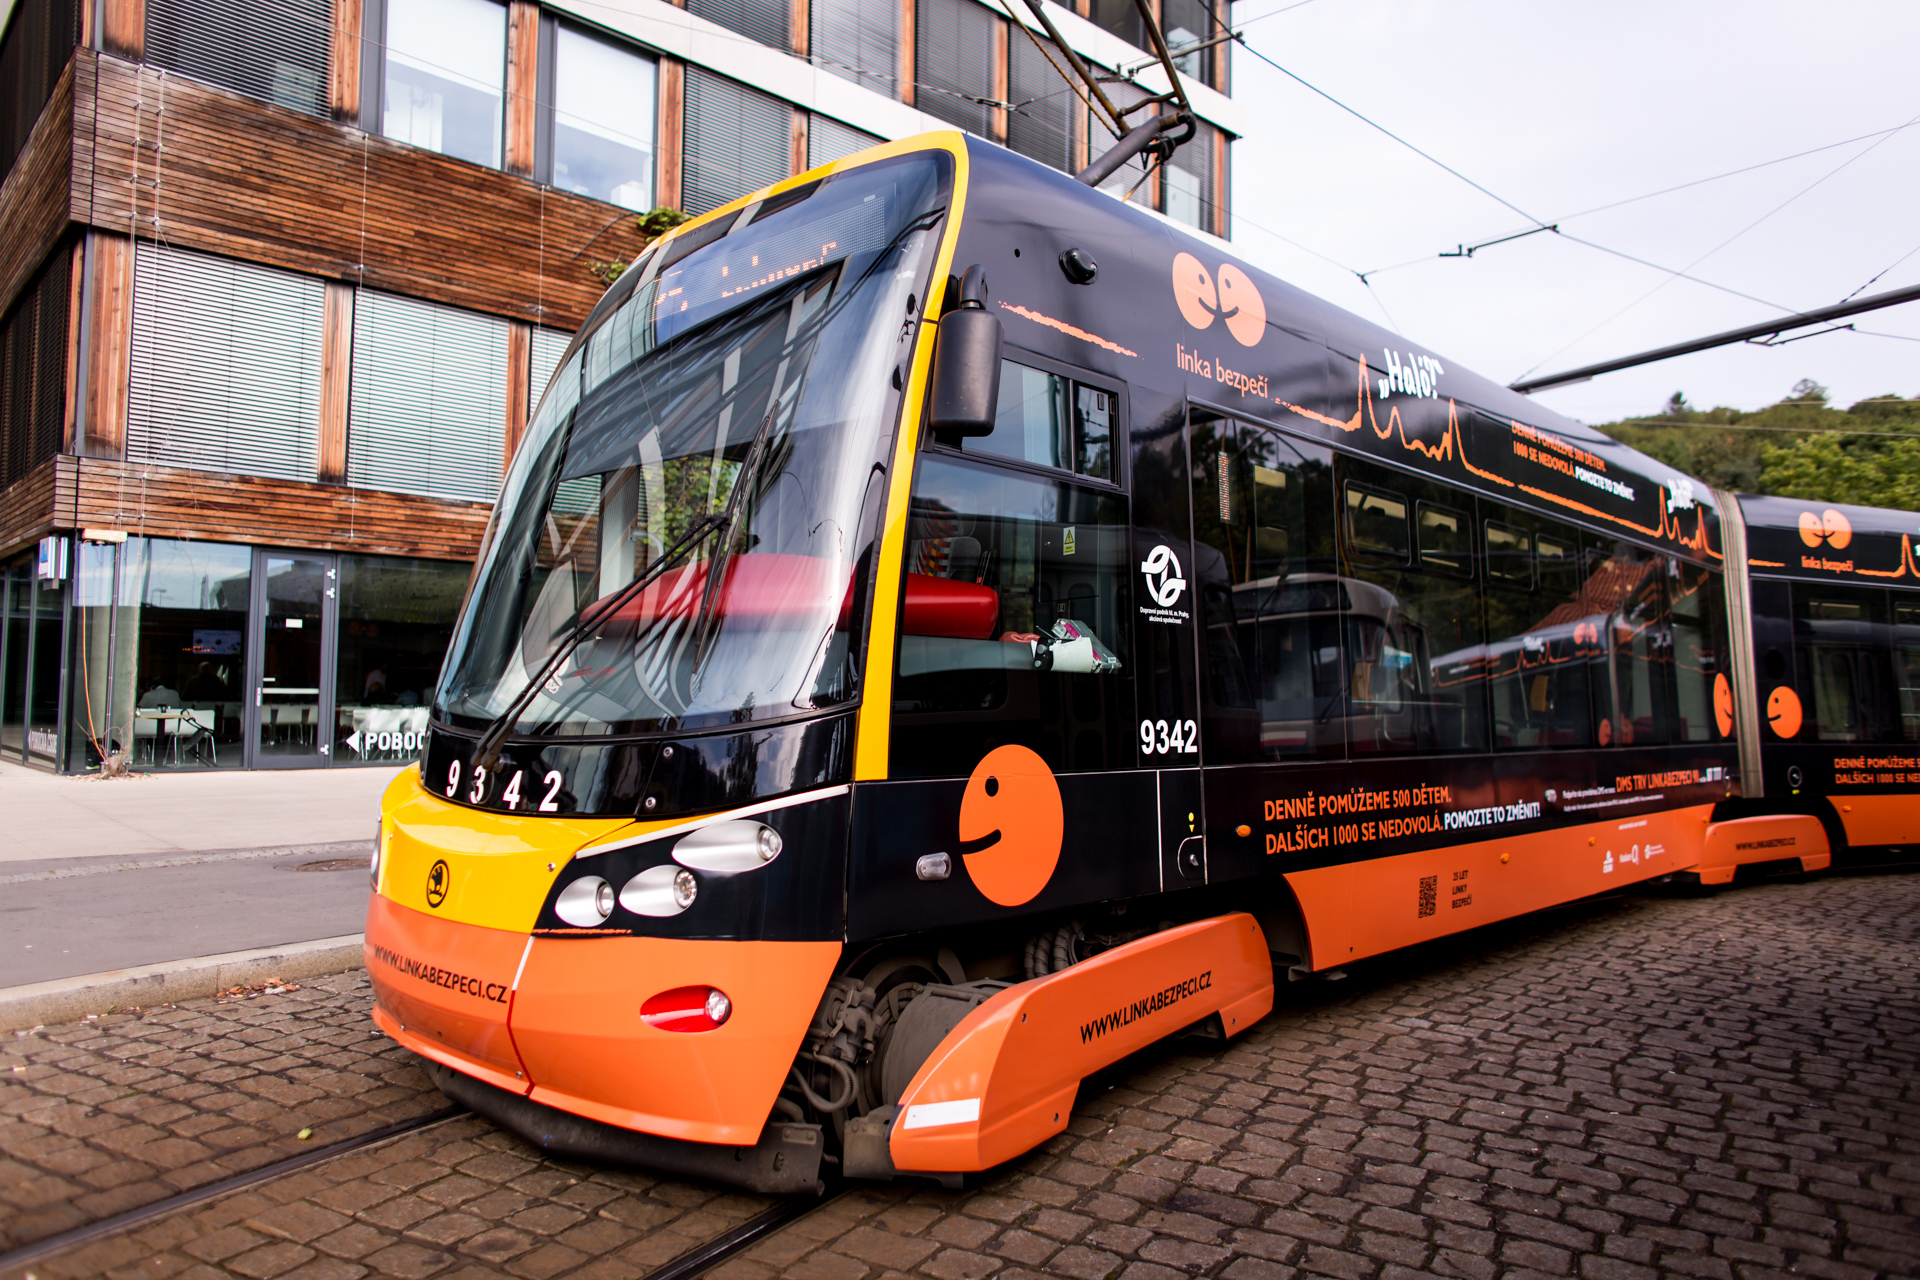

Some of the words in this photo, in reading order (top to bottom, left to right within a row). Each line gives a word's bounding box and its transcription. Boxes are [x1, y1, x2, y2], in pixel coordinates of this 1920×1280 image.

[1177, 343, 1212, 379] linka
[1216, 357, 1268, 399] bezpečí
[1528, 446, 1538, 462] SE
[1140, 719, 1198, 755] 9342
[1834, 755, 1866, 769] DENNĚ
[1867, 755, 1916, 769] POMŮŽEME
[1835, 770, 1875, 784] DALŠÍCH
[1895, 773, 1906, 784] SE
[446, 759, 562, 812] 9342
[1264, 790, 1316, 821] DENNĚ
[1319, 787, 1391, 816] POMŮŽEME
[1393, 789, 1411, 808] 500
[1412, 782, 1452, 806] DĚTEM.
[1616, 776, 1633, 792] DMS
[1633, 775, 1647, 790] TRV
[1266, 823, 1329, 855] DALŠÍCH
[1333, 823, 1359, 845] 1000
[1361, 822, 1377, 842] SE
[1379, 809, 1443, 839] NEDOVOLÁ.
[1505, 799, 1541, 822] ZMĚNIT!
[374, 943, 508, 1004] WWW.LINKABEZPECI.CZ
[1080, 970, 1212, 1045] WWW.LINKABEZPECI.CZ
